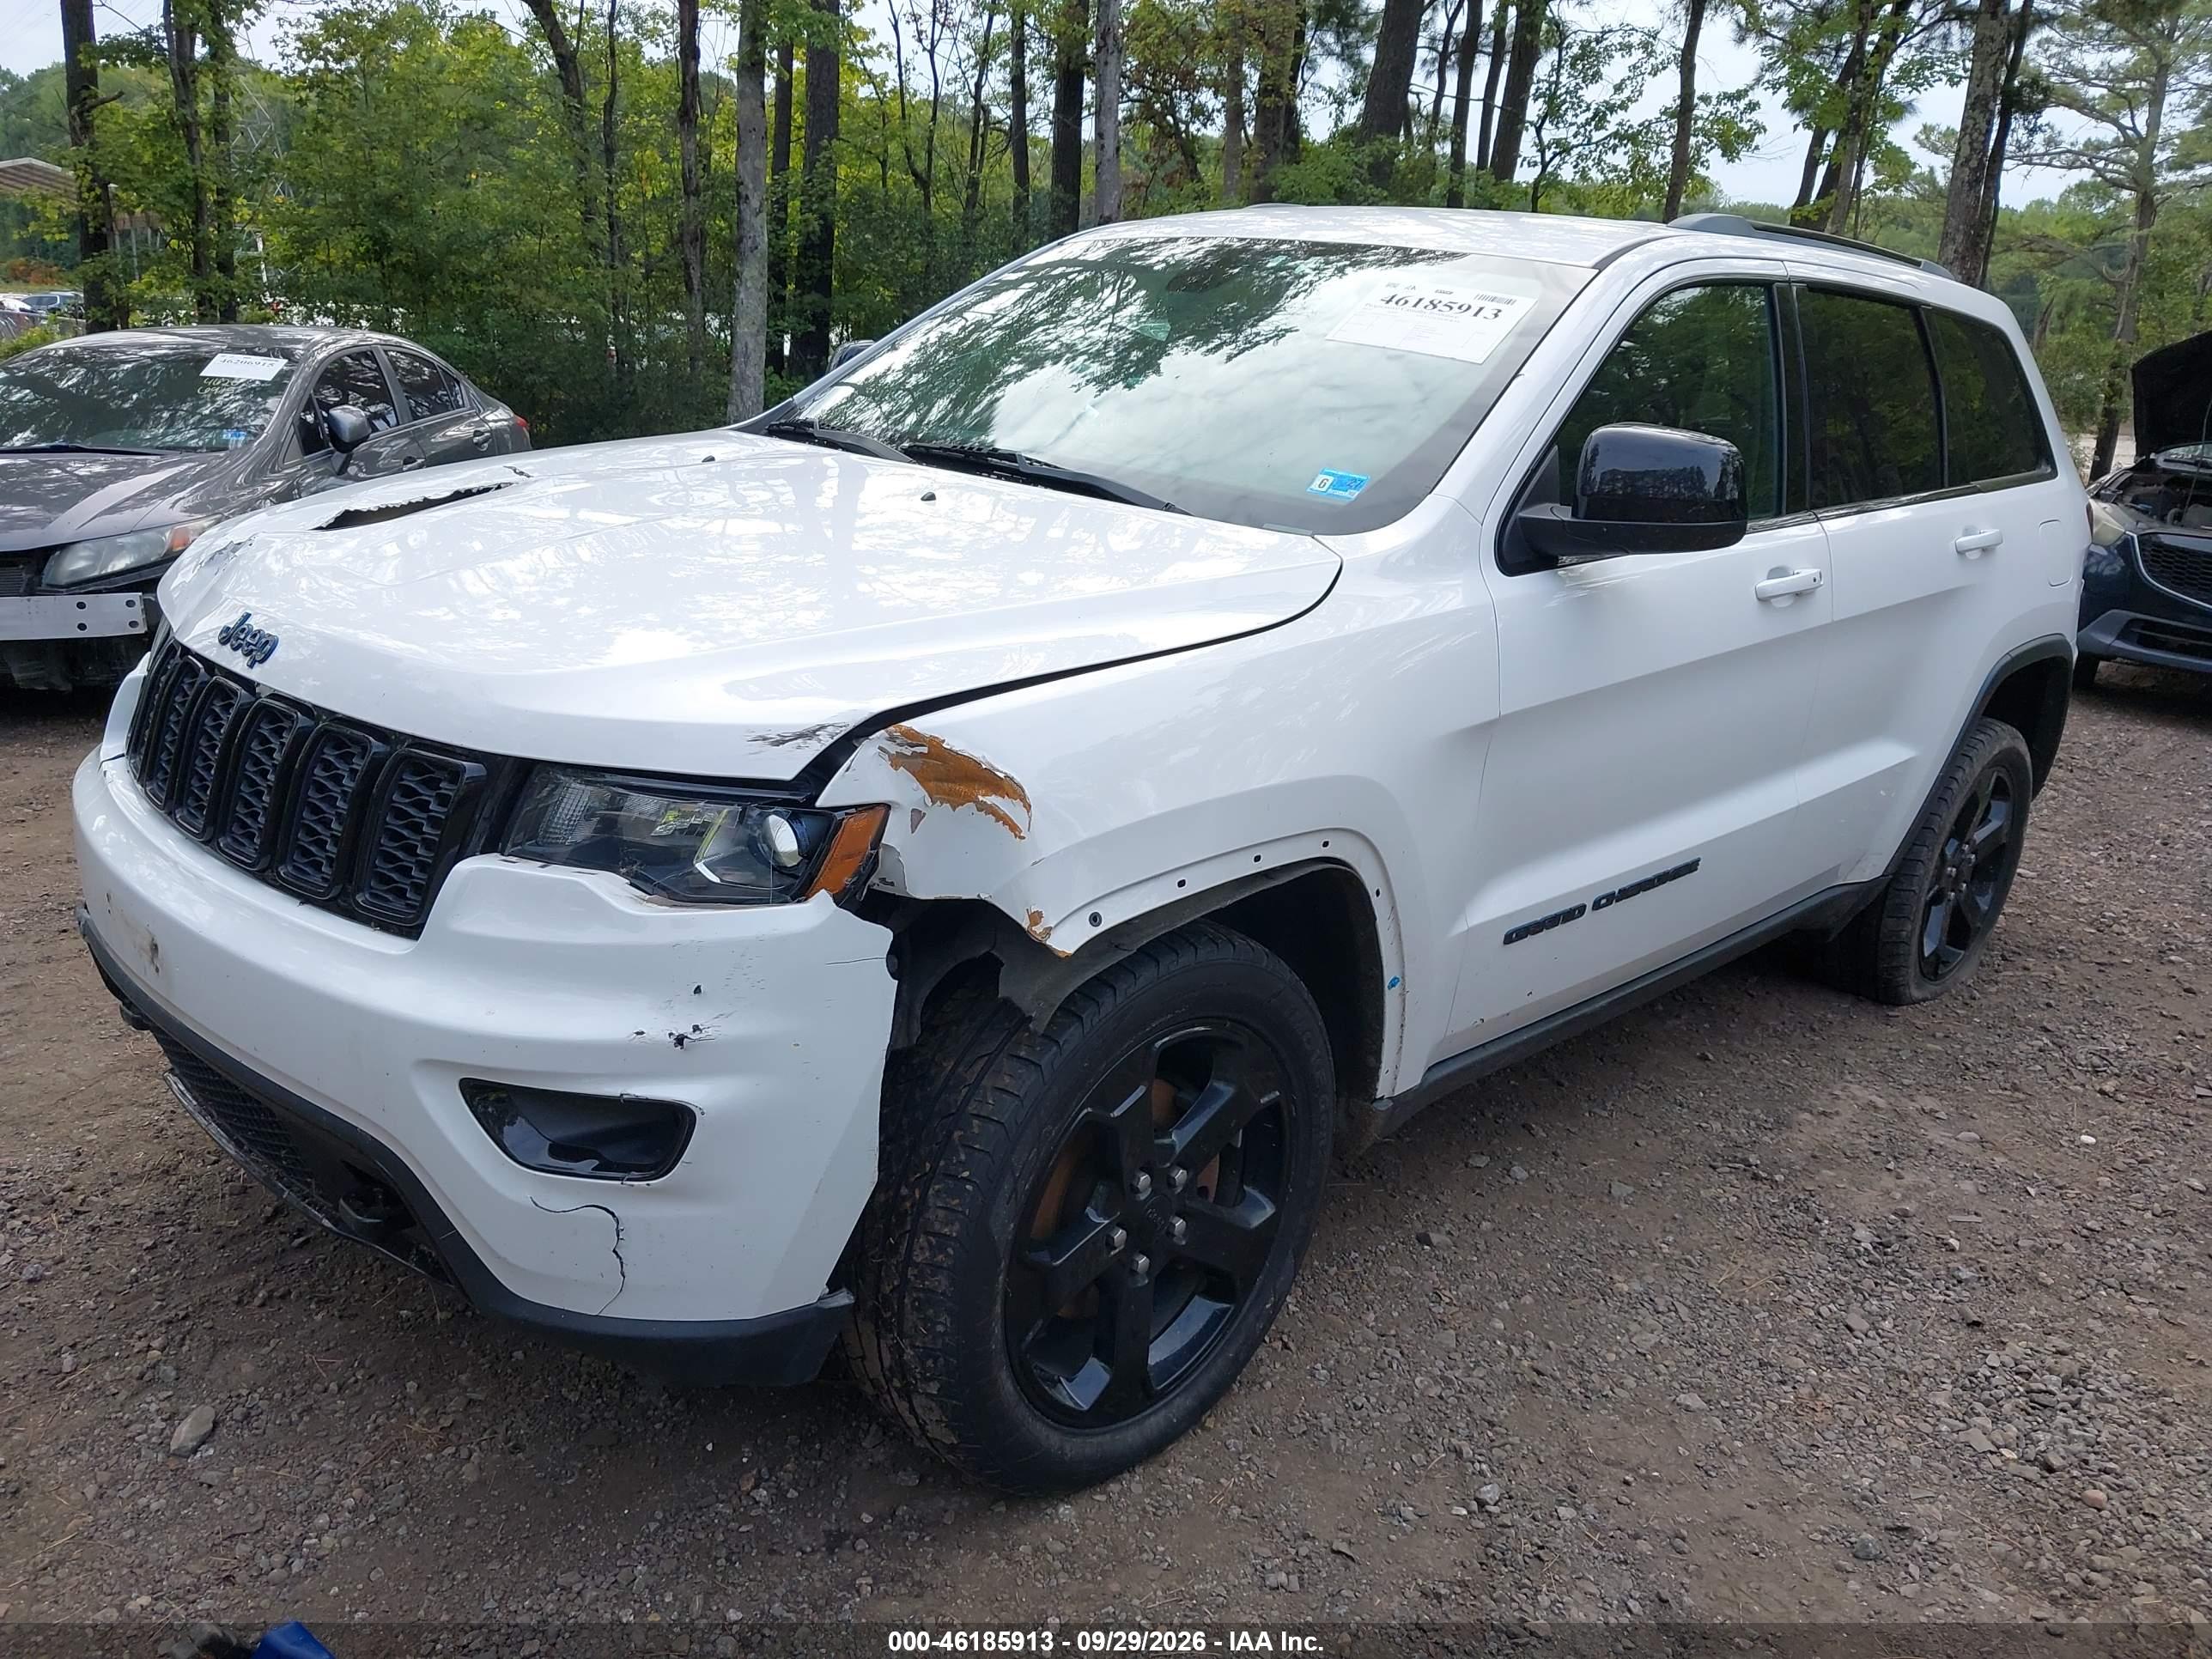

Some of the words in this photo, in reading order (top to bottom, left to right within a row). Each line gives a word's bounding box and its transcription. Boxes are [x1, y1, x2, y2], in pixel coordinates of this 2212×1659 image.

[1380, 294, 1503, 319] 46185913
[217, 611, 279, 669] Jeep
[1503, 902, 1588, 945] GRAND
[1591, 857, 1701, 911] CHEROKEE
